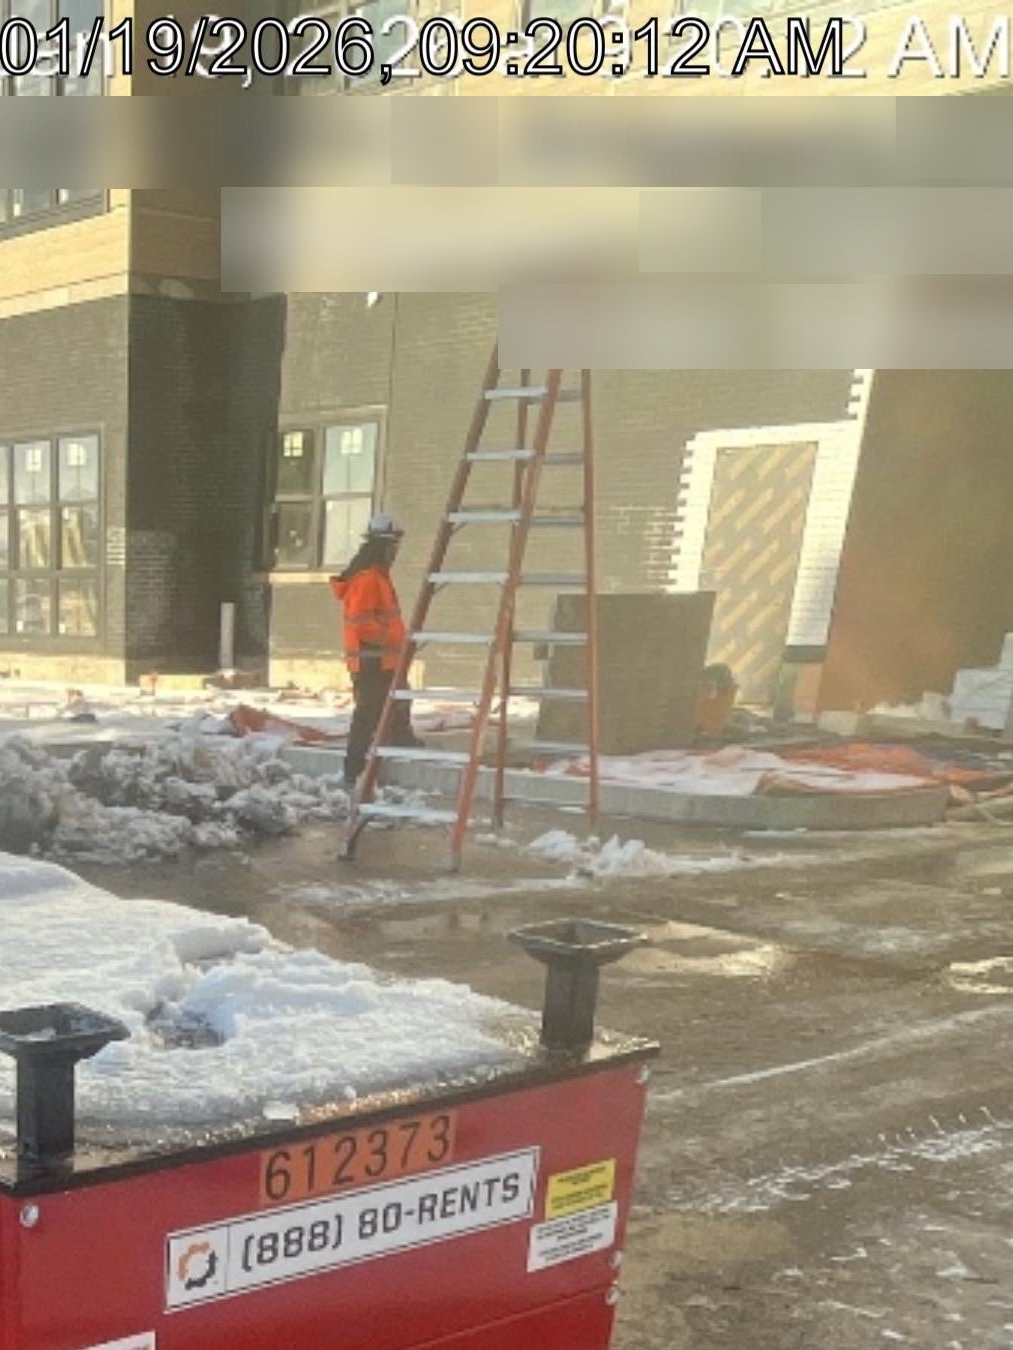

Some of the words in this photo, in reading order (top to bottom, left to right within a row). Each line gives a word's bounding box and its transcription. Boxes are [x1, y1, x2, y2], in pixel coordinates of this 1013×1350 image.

[265, 1115, 450, 1200] 612373
[242, 1214, 342, 1272] (888)
[358, 1173, 520, 1239] 80-RENTS
